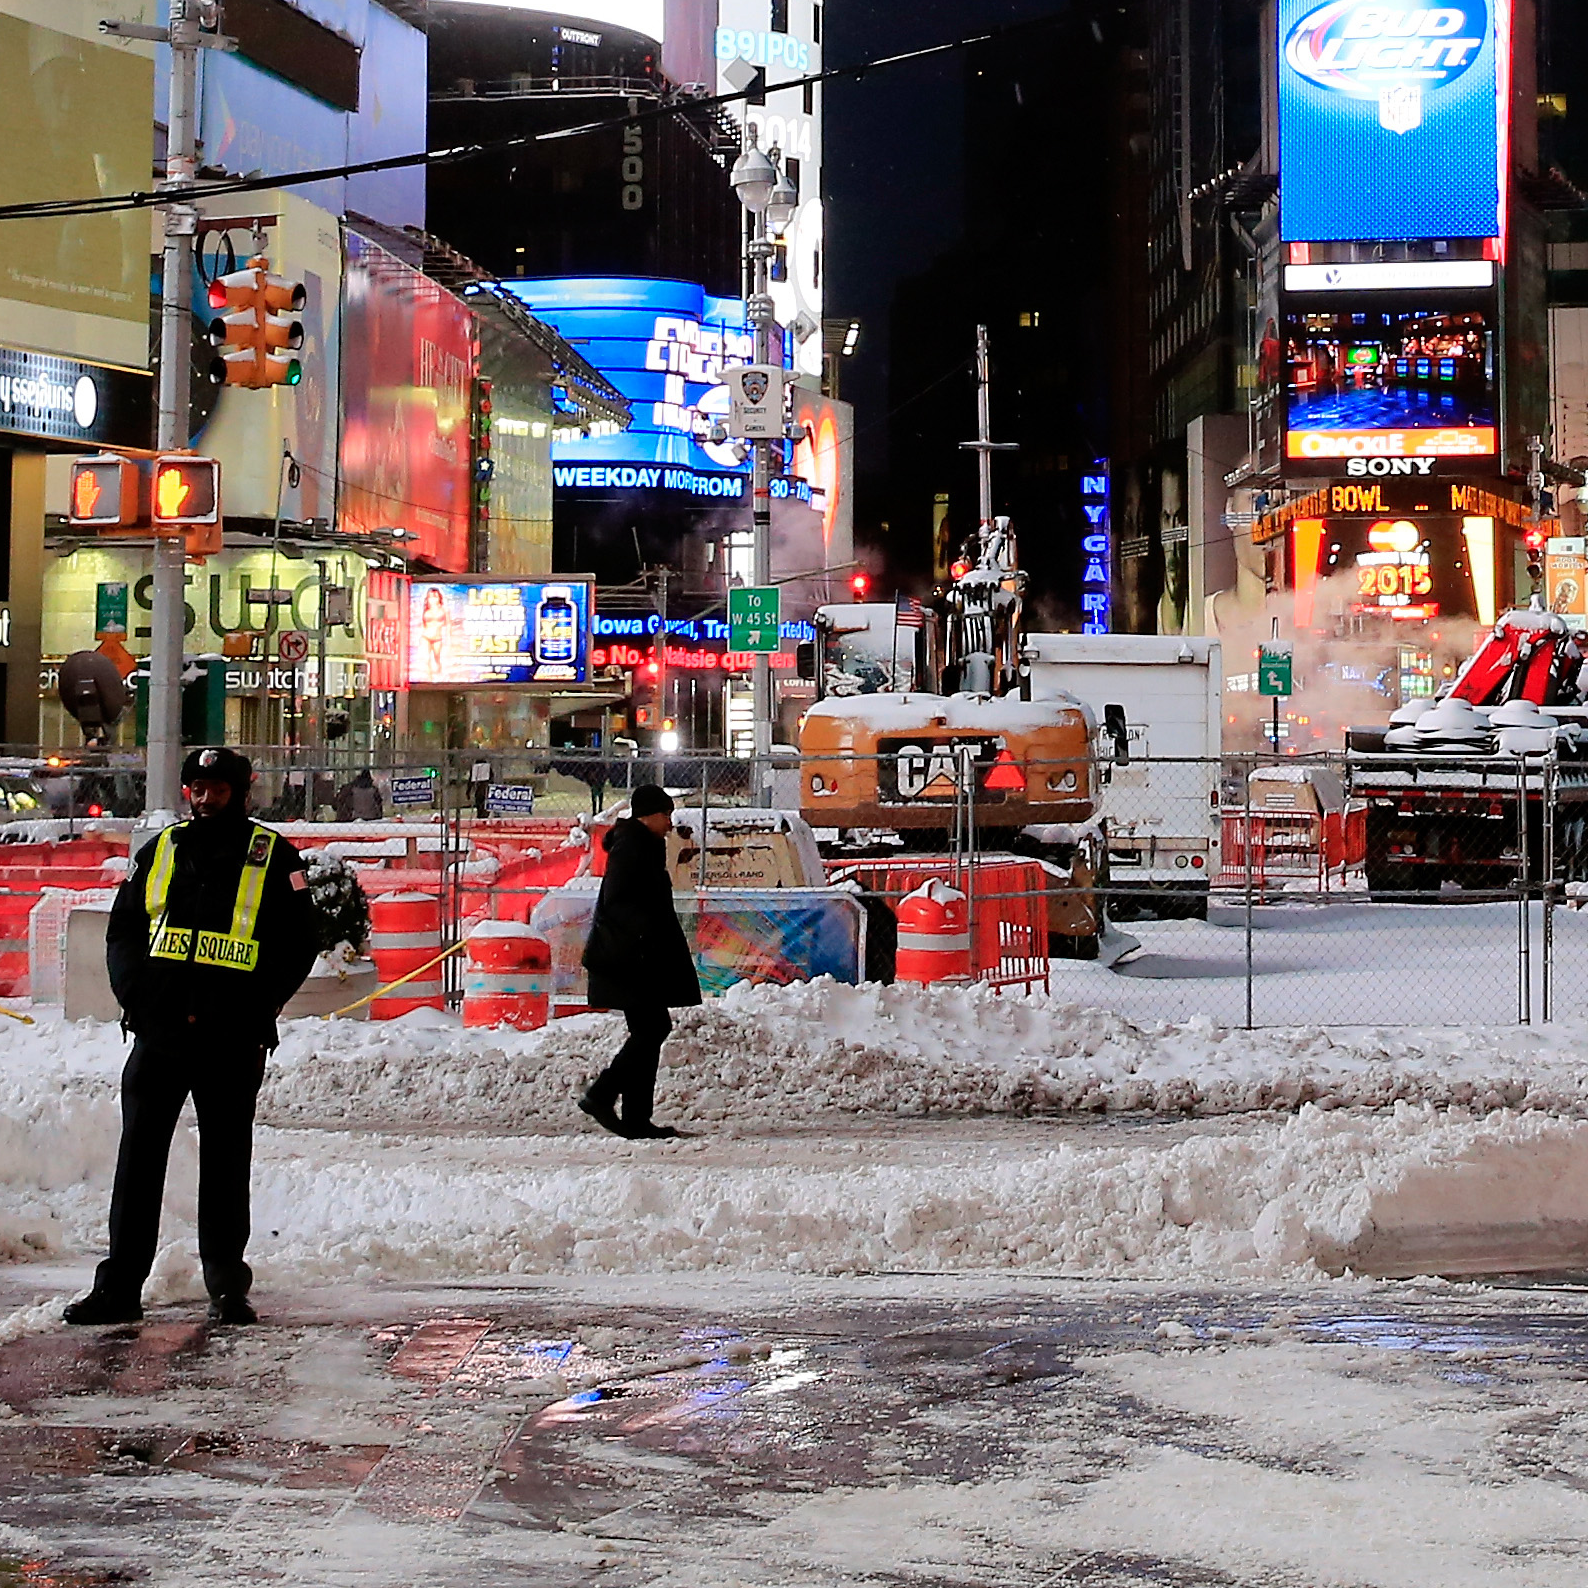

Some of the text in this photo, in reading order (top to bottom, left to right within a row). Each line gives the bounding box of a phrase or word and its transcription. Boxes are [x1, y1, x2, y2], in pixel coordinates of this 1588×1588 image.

[1341, 6, 1465, 40] BUD
[561, 27, 600, 46] OUTFRONT
[12, 372, 74, 417] sunglass
[1346, 457, 1437, 476] SONY
[553, 467, 662, 488] WEEKDAY
[691, 476, 743, 497] FROM
[1332, 485, 1390, 512] BOWL
[1356, 564, 1433, 596] 2015
[468, 589, 522, 606] LOSE
[748, 595, 761, 607] To
[464, 605, 526, 621] WATER
[732, 612, 777, 625] W 45 St
[592, 614, 643, 634] Iowa
[470, 636, 521, 653] FAST
[393, 779, 431, 791] Federal
[488, 787, 532, 801] Federal
[198, 935, 254, 966] SQUARE
